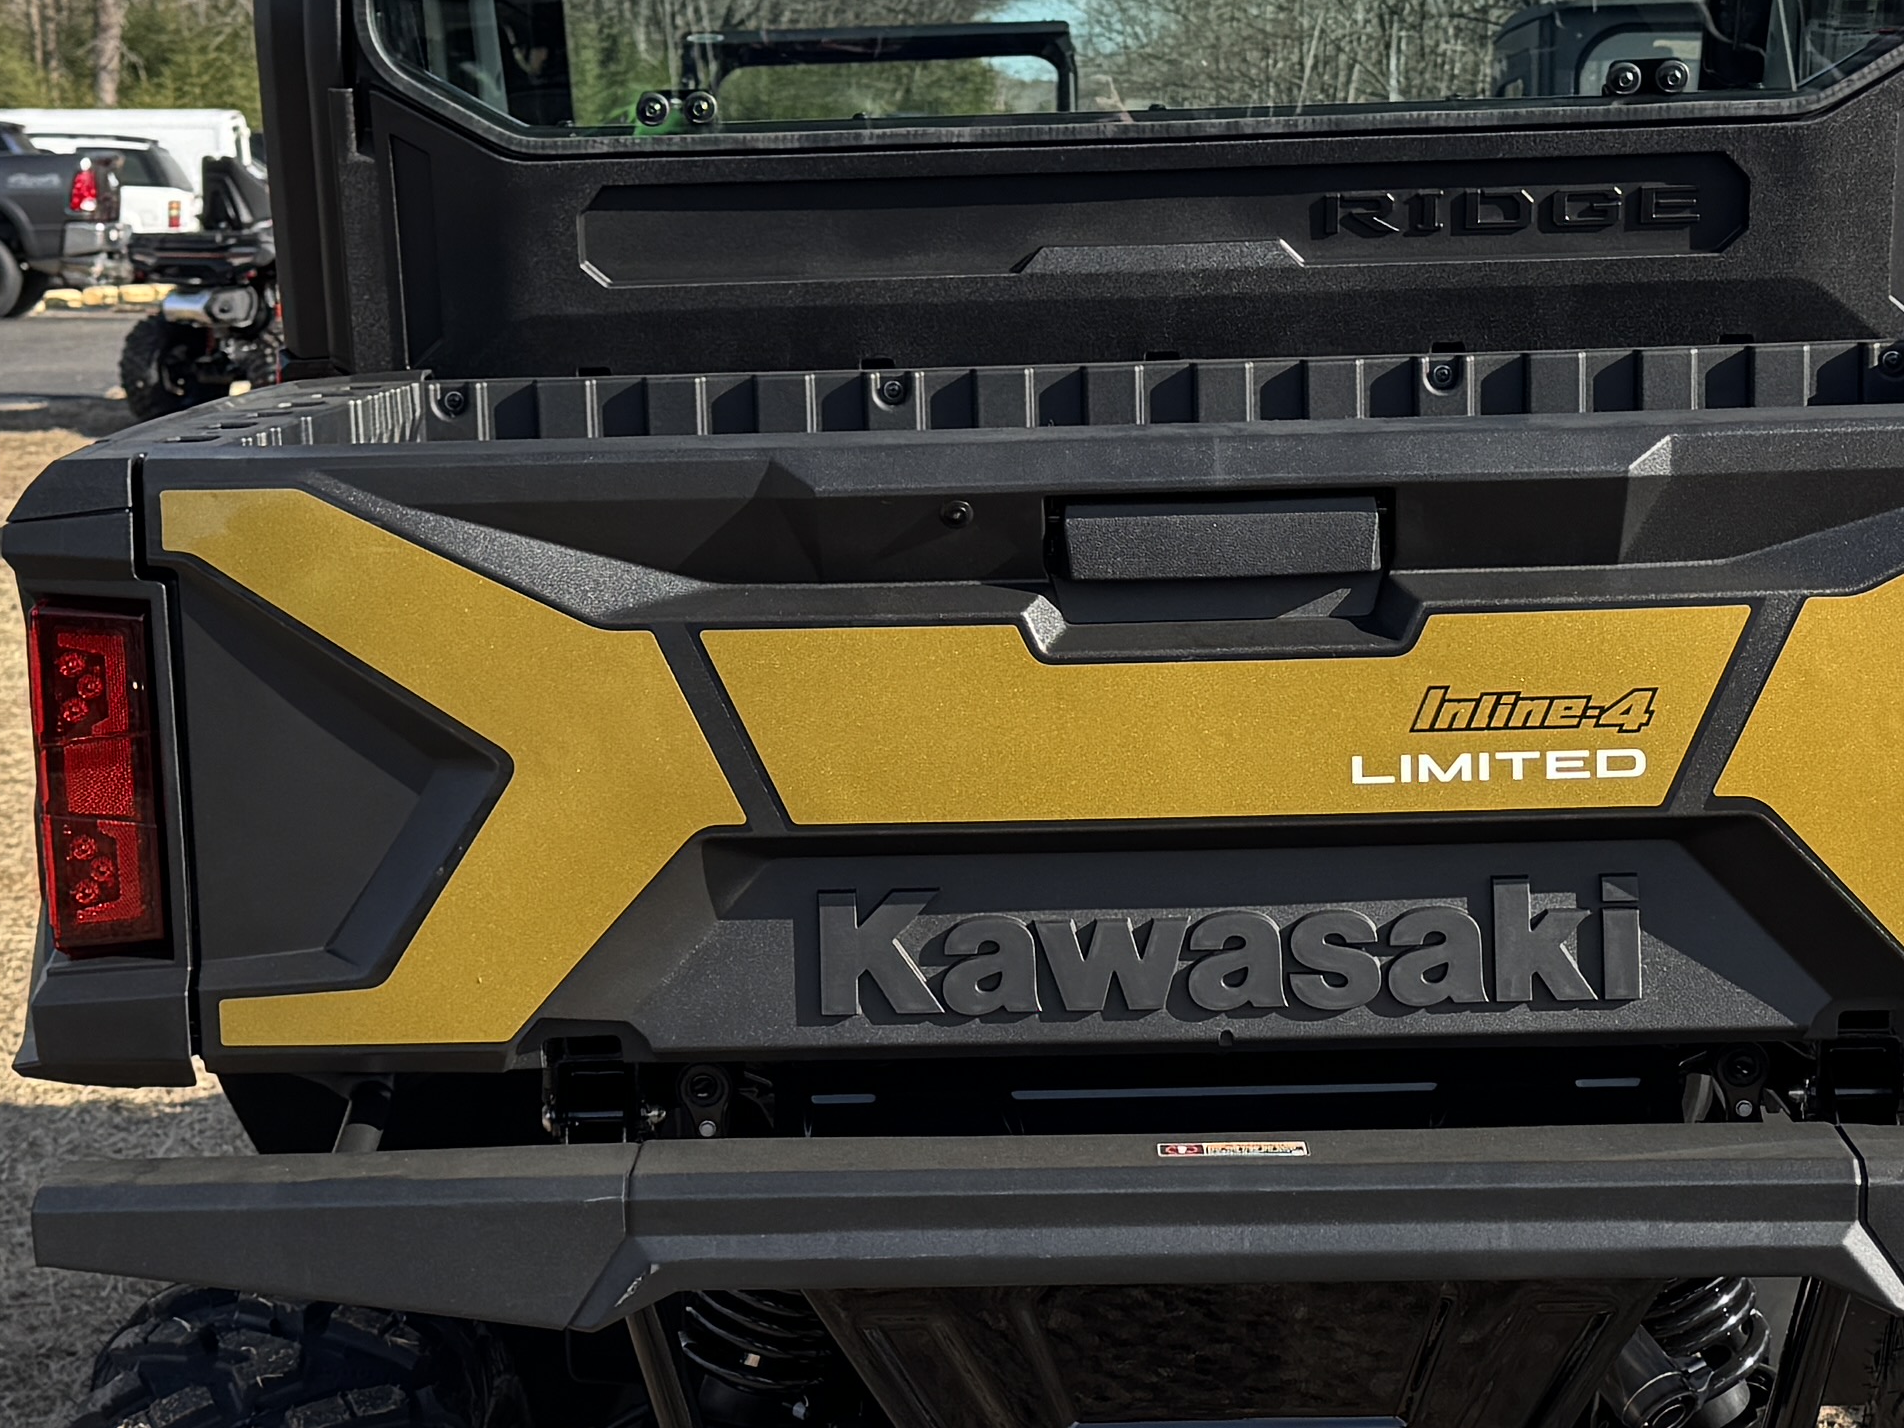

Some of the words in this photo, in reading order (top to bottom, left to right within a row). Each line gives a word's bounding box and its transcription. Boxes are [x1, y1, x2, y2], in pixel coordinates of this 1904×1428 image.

[1322, 184, 1701, 235] RIDGE
[1409, 685, 1659, 733] Inline-4
[1351, 748, 1647, 785] LIMITED
[815, 872, 1643, 1018] Kawasaki
